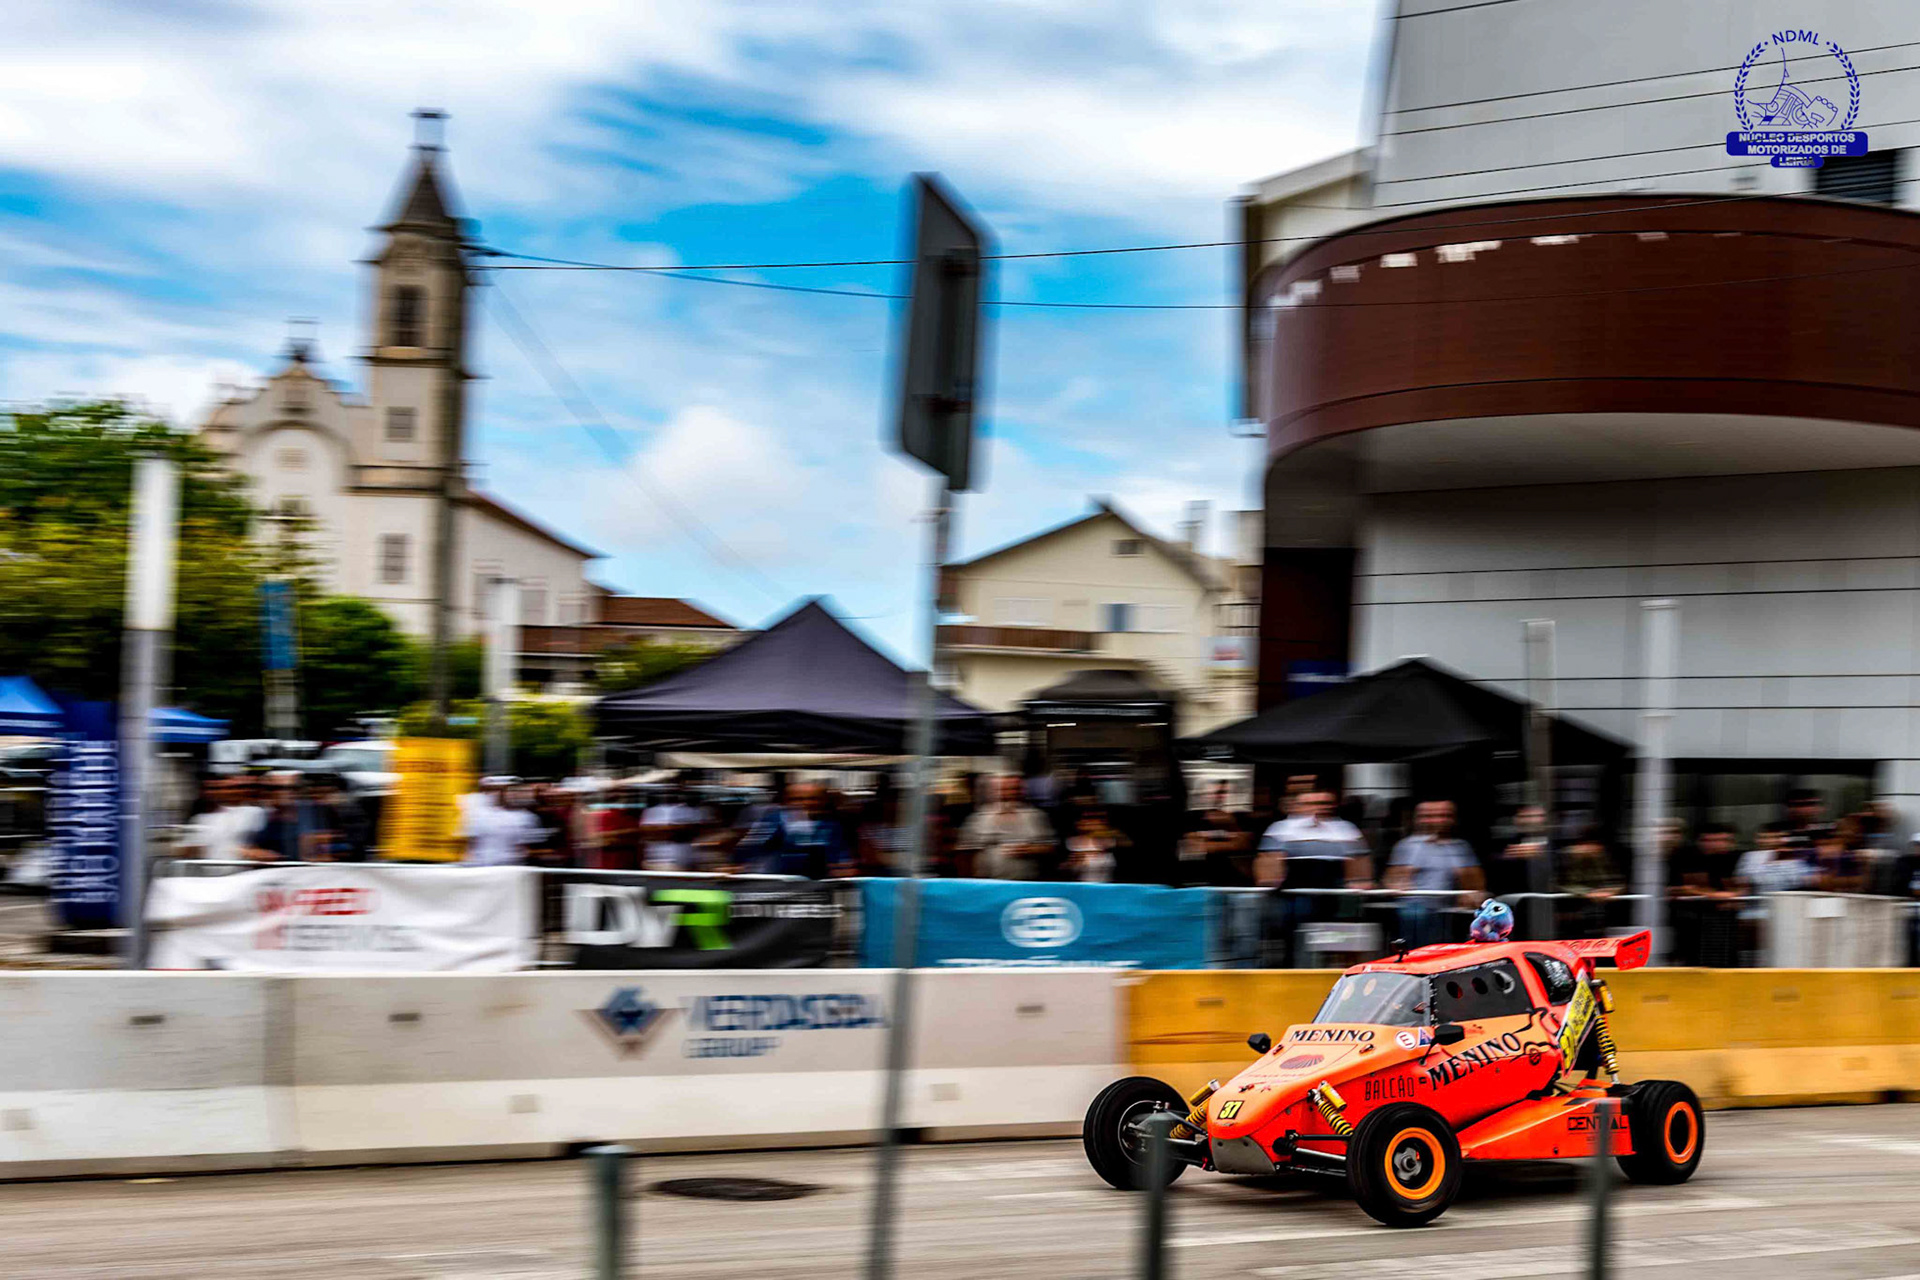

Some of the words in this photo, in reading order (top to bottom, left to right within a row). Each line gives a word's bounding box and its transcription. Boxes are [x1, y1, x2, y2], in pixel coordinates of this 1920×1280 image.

[1289, 1029, 1375, 1042] MENINO
[1428, 1032, 1521, 1091] MENINO
[1219, 1100, 1243, 1119] 37
